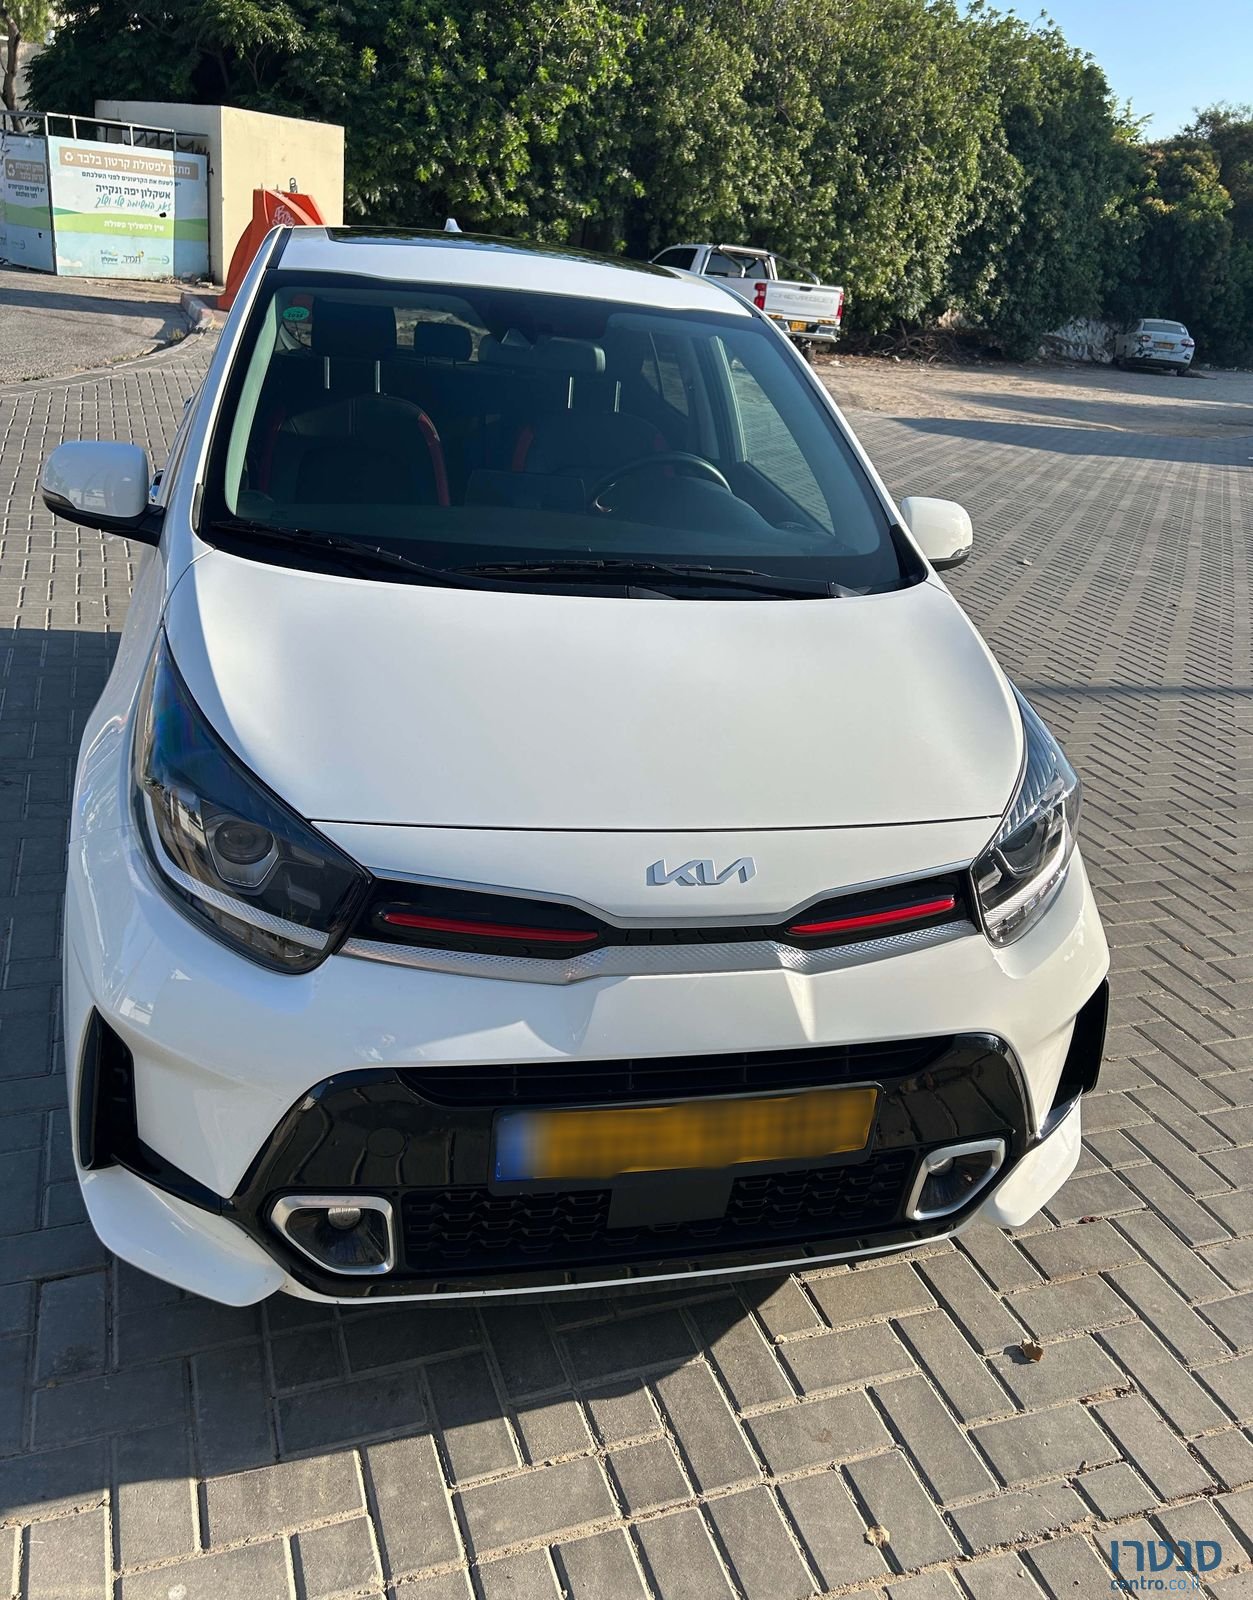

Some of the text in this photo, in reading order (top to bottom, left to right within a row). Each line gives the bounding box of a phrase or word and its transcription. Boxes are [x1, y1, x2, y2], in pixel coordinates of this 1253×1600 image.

[77, 153, 102, 164] בלבד
[104, 157, 129, 169] קרטון
[133, 160, 166, 172] לפסולת
[82, 171, 106, 179] השלכתם
[96, 184, 171, 200] אשקלון יפה ונקייה
[95, 194, 111, 208] ושלך
[115, 195, 125, 207] שלי
[127, 200, 155, 209] המשימה
[646, 857, 757, 886] KIA
